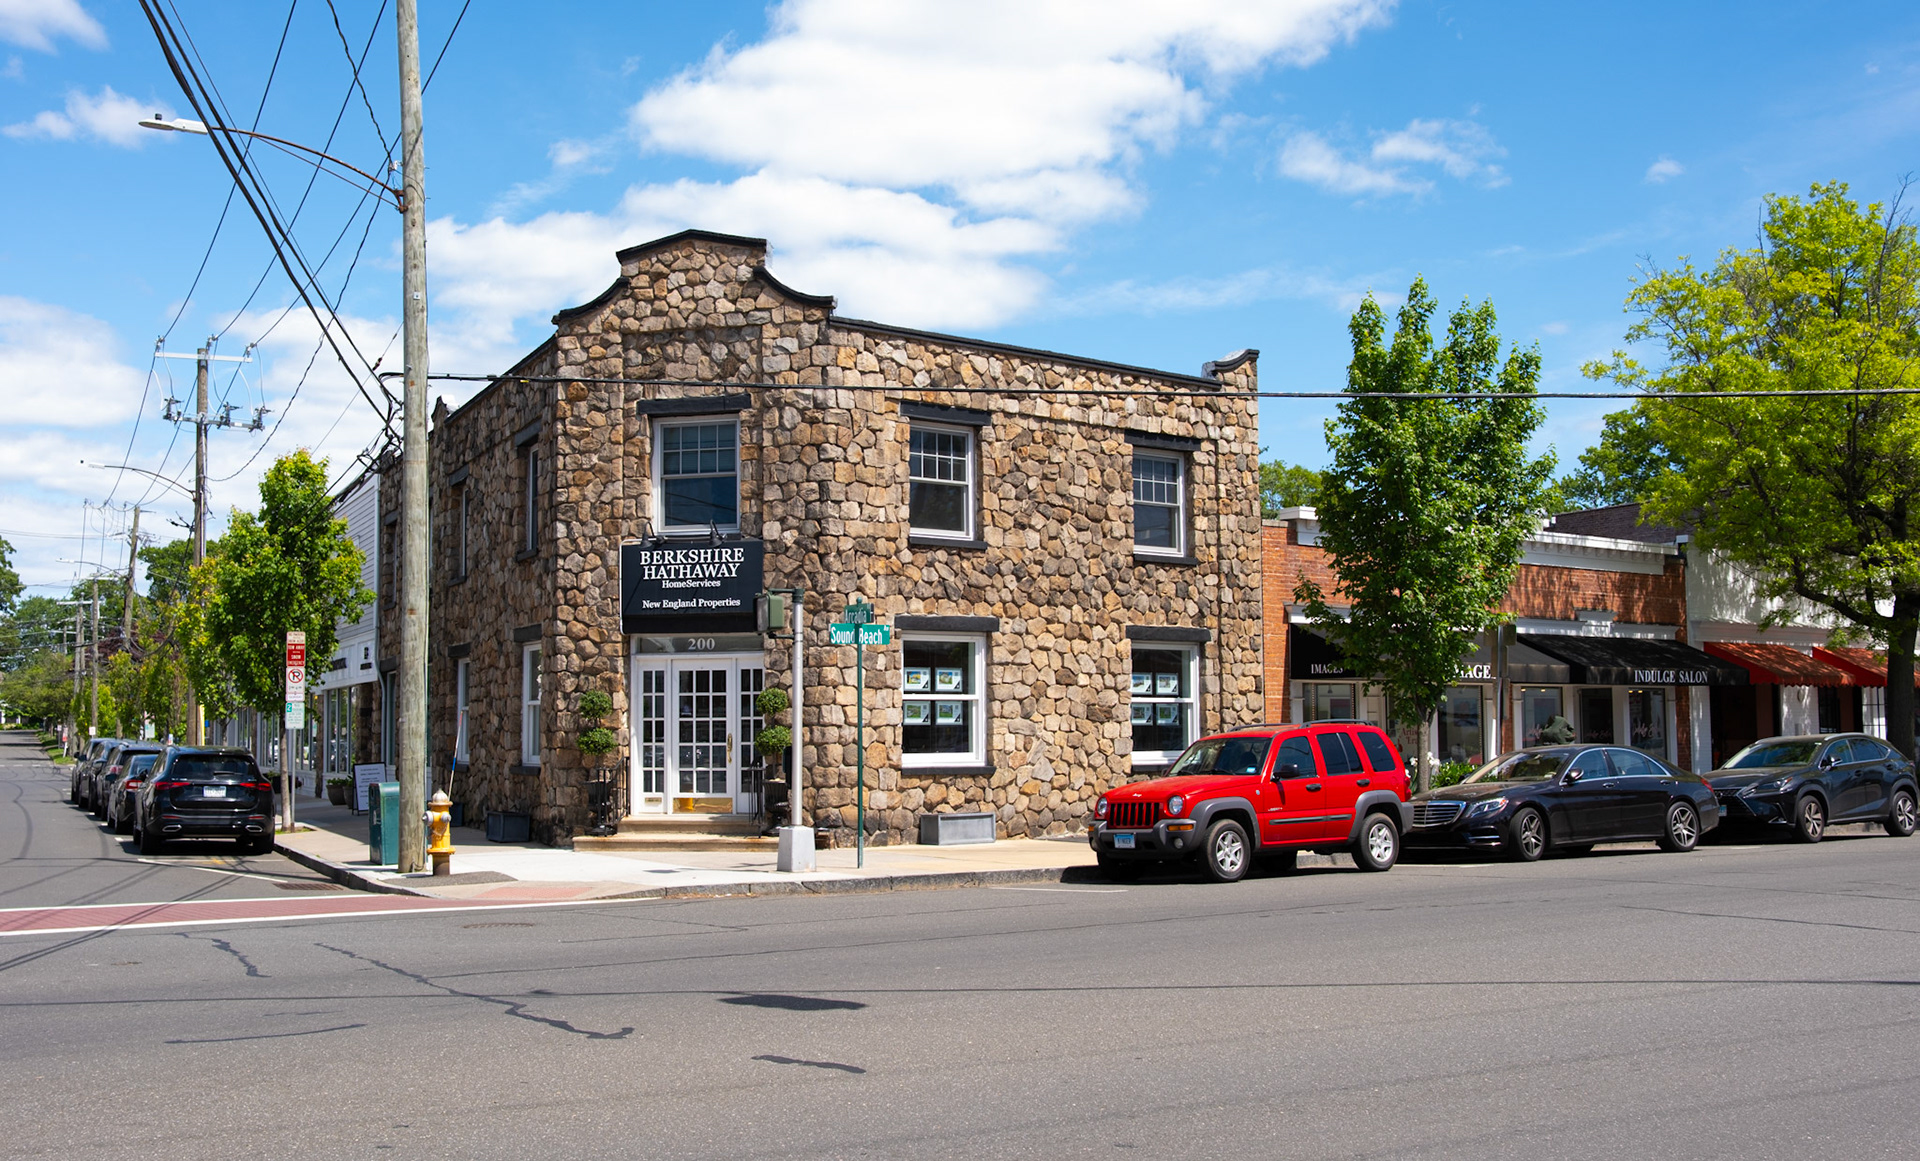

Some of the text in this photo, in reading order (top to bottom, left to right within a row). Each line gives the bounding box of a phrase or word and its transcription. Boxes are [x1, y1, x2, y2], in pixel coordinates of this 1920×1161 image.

[640, 548, 744, 565] BERKSHIRE
[643, 563, 740, 580] HATHAWAY
[662, 579, 721, 588] HomeServices
[642, 597, 741, 610] New England Properties
[859, 628, 883, 644] Beach
[688, 638, 715, 650] 200
[1634, 670, 1708, 683] INDULGE SALON
